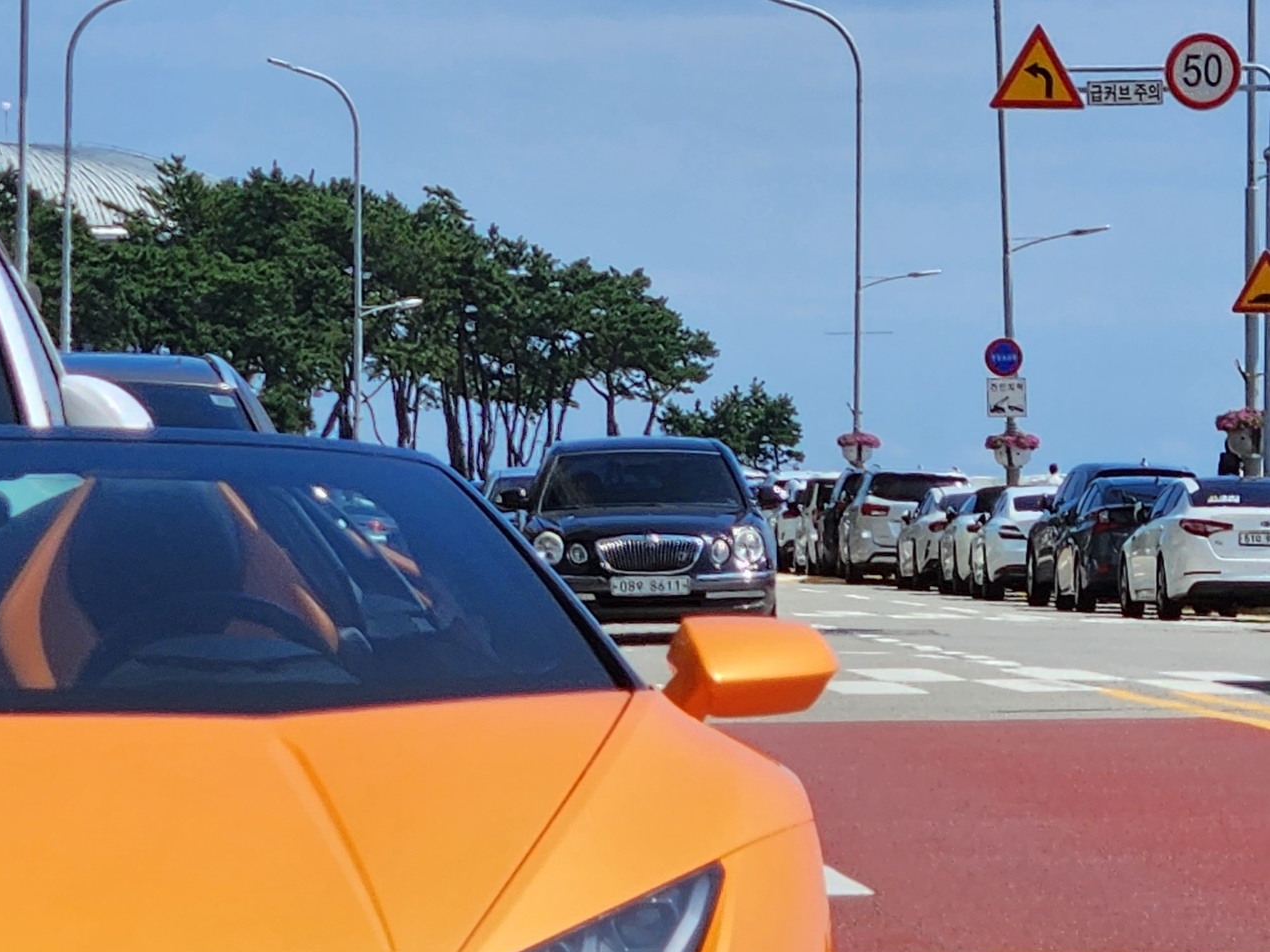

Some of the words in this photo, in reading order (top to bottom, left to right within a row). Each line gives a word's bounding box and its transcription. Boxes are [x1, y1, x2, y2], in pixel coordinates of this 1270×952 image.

[1183, 54, 1222, 87] 50
[1090, 84, 1132, 102] 급커브
[1134, 83, 1160, 101] 주의
